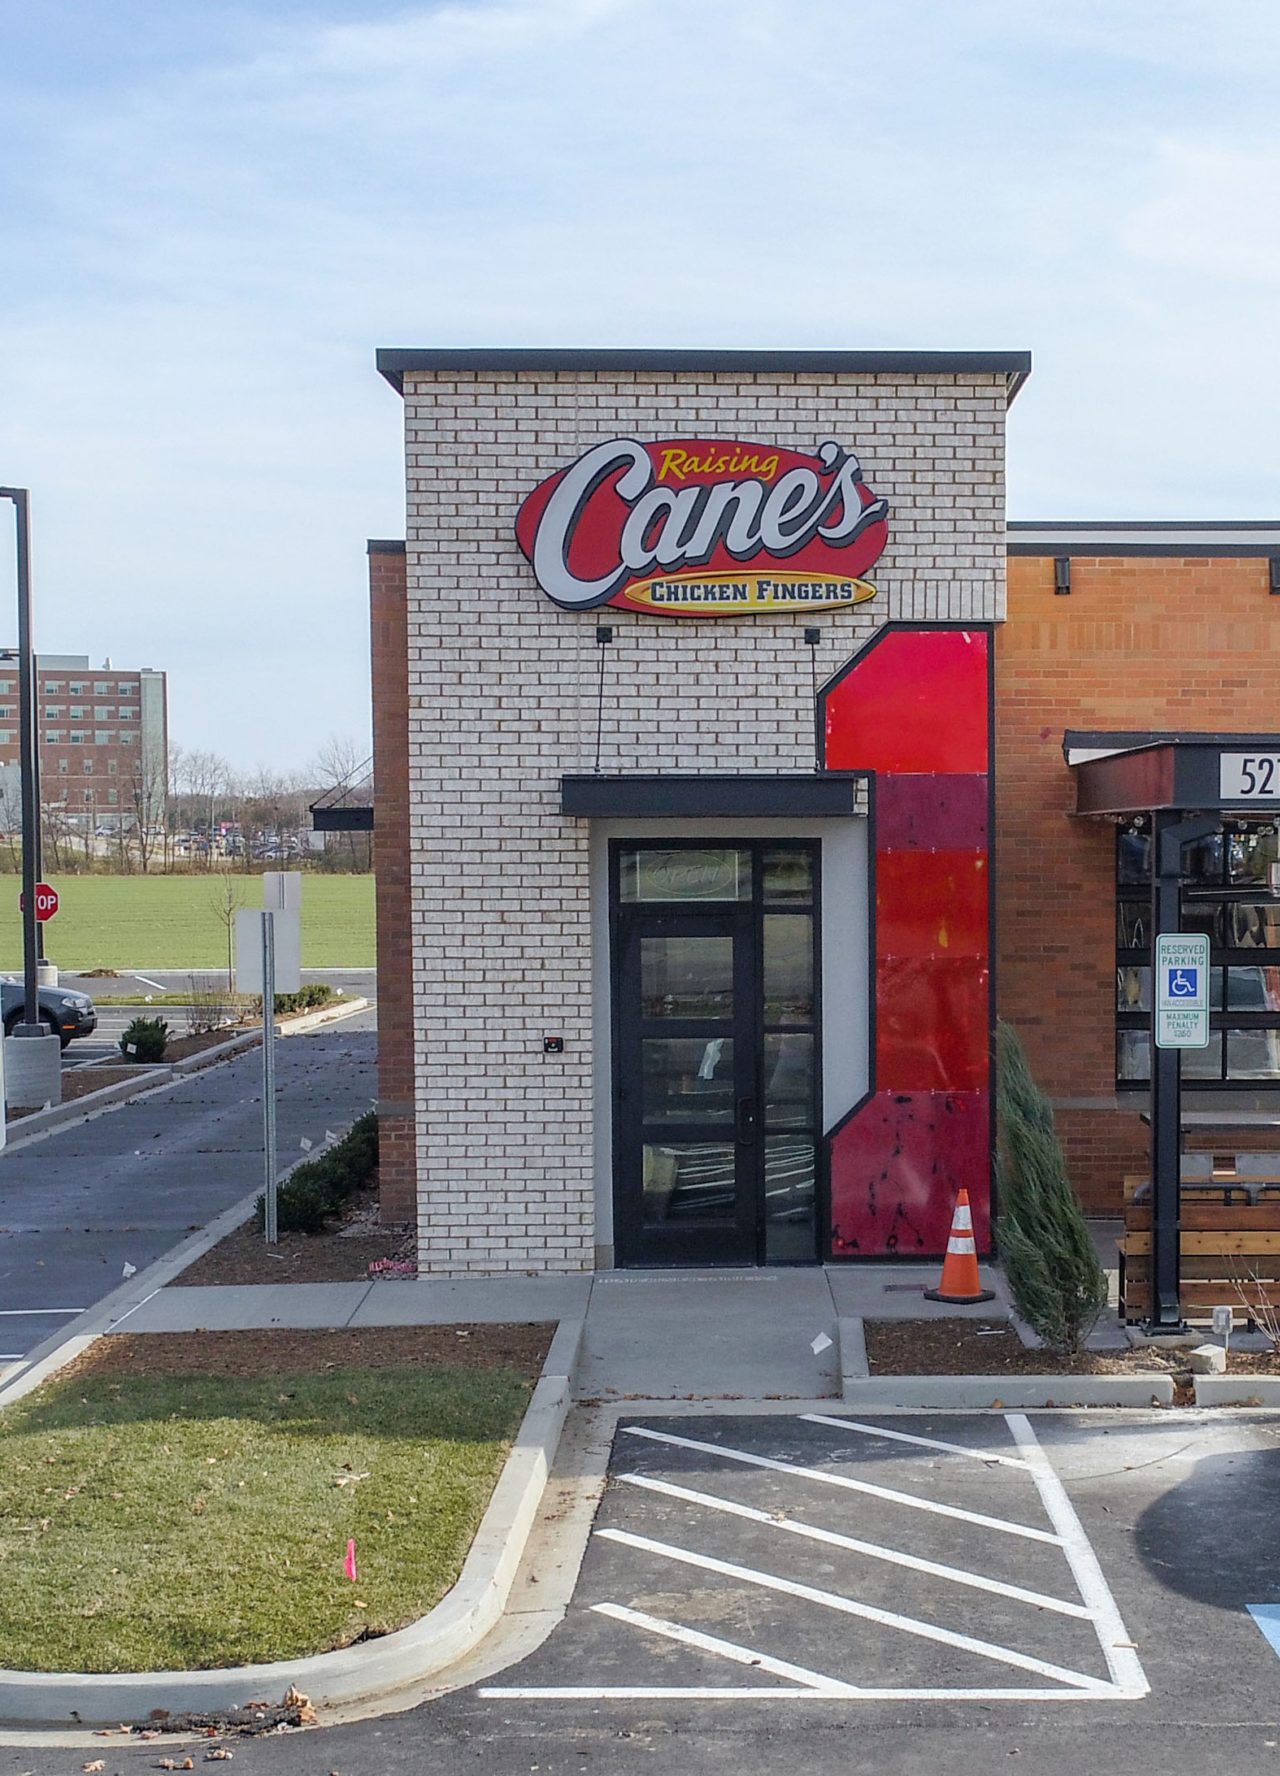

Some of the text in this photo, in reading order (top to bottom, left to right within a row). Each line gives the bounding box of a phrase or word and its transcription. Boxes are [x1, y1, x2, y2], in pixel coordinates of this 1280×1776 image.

[658, 448, 780, 481] Raising
[534, 438, 889, 610] Cane's
[650, 579, 853, 602] CHICKEN FINGERS
[1161, 944, 1205, 955] RESERVED
[1162, 956, 1204, 966] PARKING
[1166, 1012, 1200, 1020] MAXIMUM
[1167, 1021, 1199, 1029] PENALTY
